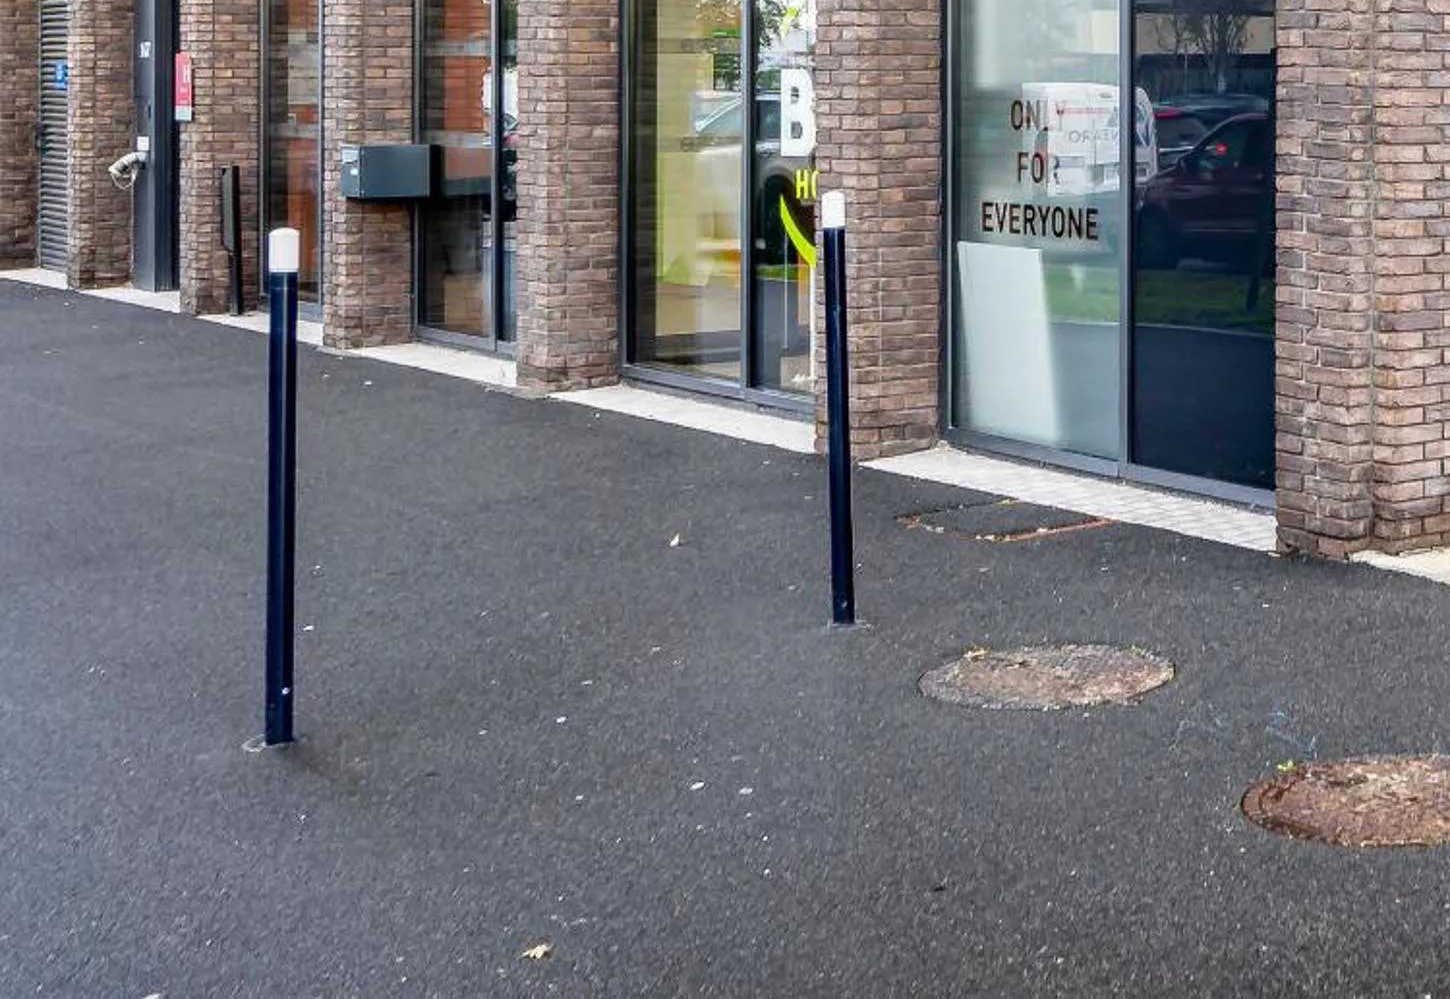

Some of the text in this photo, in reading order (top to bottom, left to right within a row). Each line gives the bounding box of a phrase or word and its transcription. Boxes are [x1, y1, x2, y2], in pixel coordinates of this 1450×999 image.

[1011, 100, 1066, 132] ONLY
[1017, 152, 1061, 184] FOR
[981, 202, 1099, 241] EVERYONE
